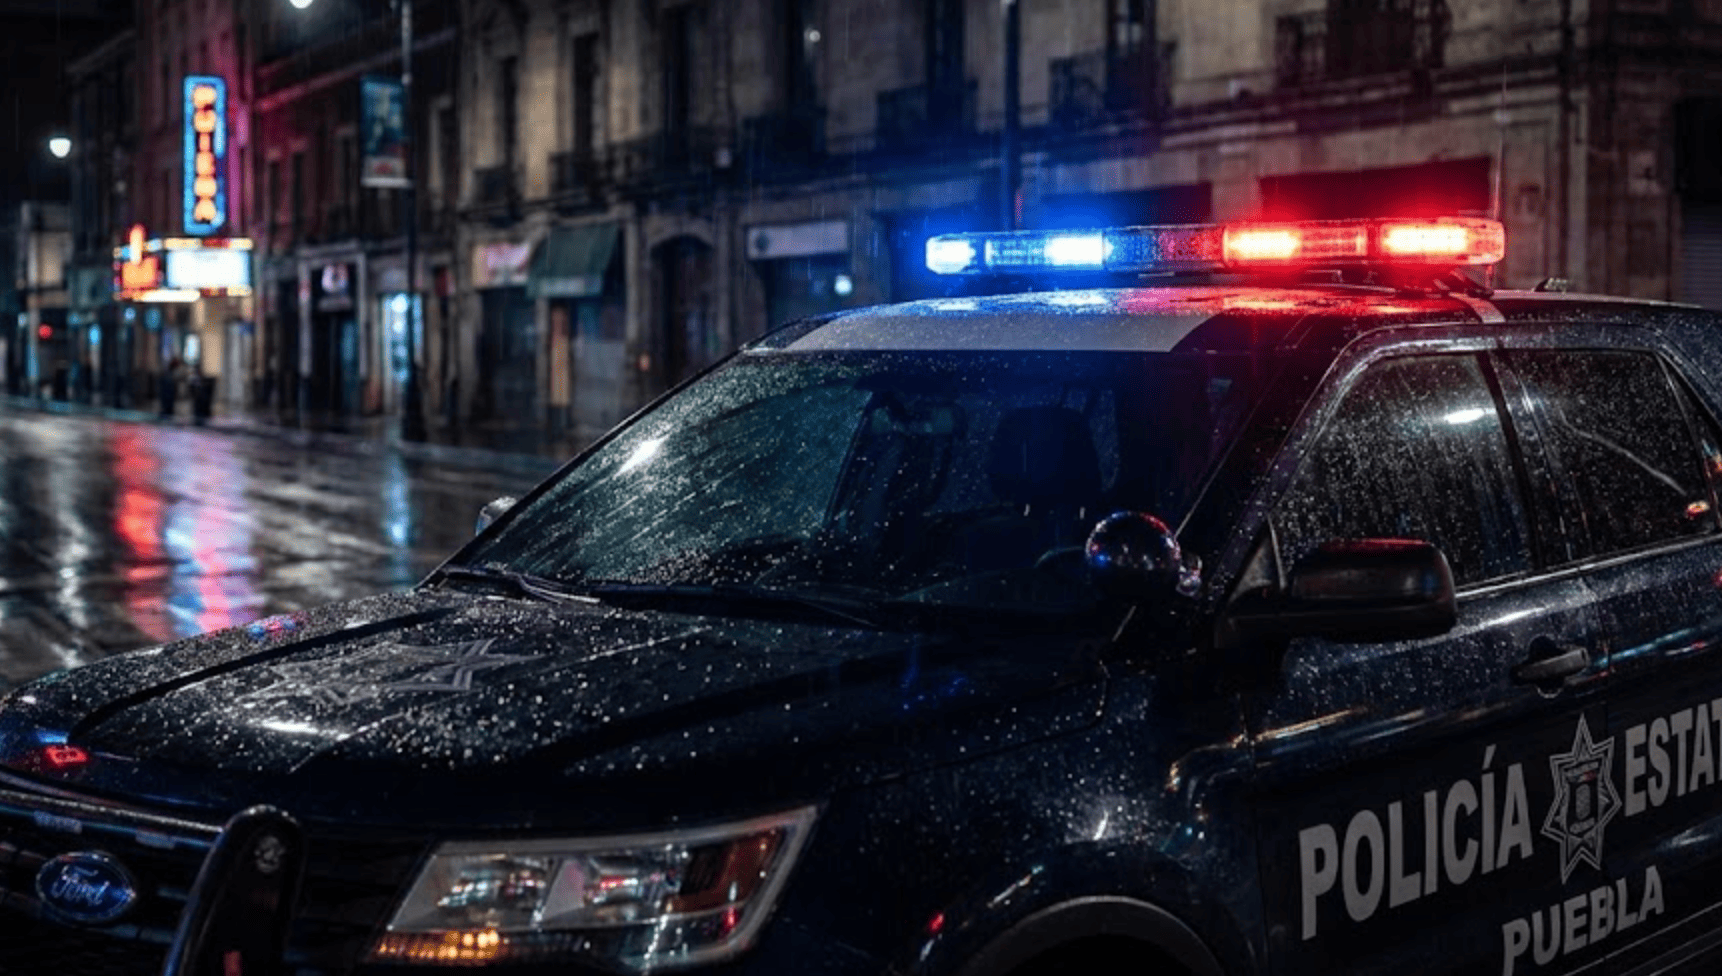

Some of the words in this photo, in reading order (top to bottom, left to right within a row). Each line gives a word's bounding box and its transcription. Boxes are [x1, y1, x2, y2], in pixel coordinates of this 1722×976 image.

[51, 865, 110, 906] Ford
[1299, 744, 1534, 942] POLICÍA
[1503, 866, 1664, 976] PUEBLA
